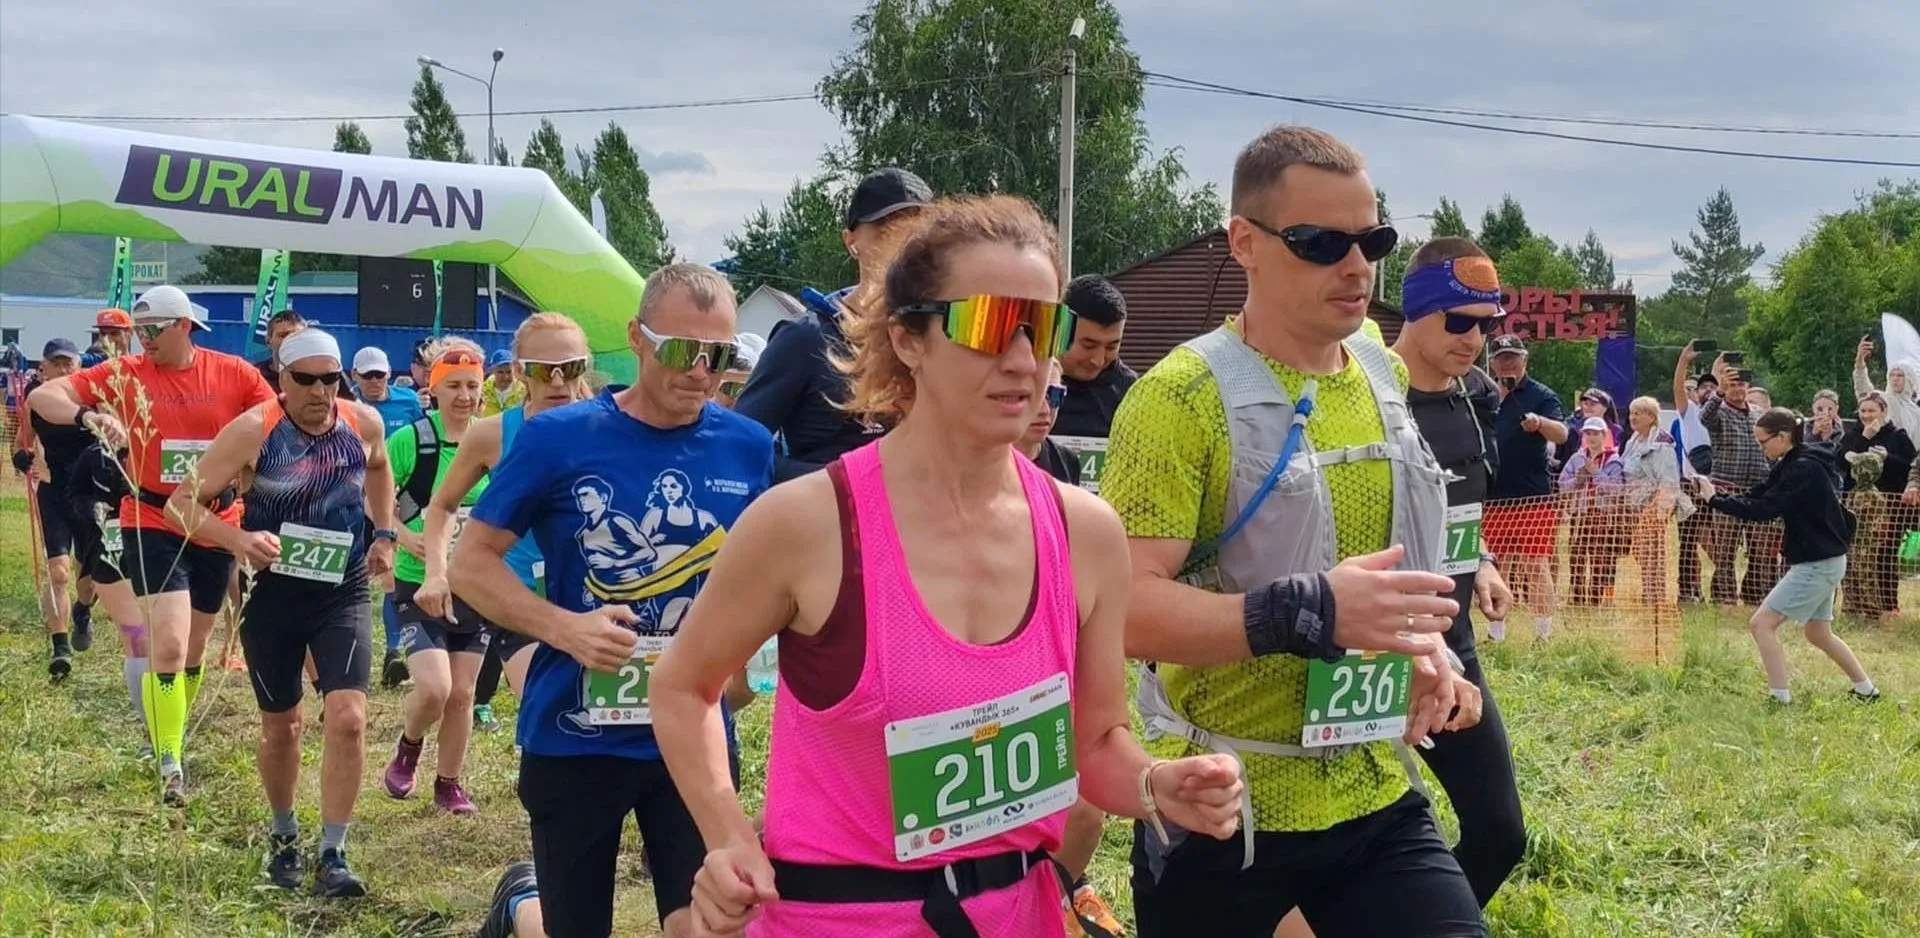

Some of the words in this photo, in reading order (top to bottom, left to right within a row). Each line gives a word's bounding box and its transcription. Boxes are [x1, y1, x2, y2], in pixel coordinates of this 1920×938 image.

[411, 283, 422, 299] 6
[1077, 454, 1097, 479] 4
[288, 542, 337, 569] 247
[1327, 662, 1394, 718] 236
[975, 723, 998, 739] 2025
[934, 731, 1040, 818] 210
